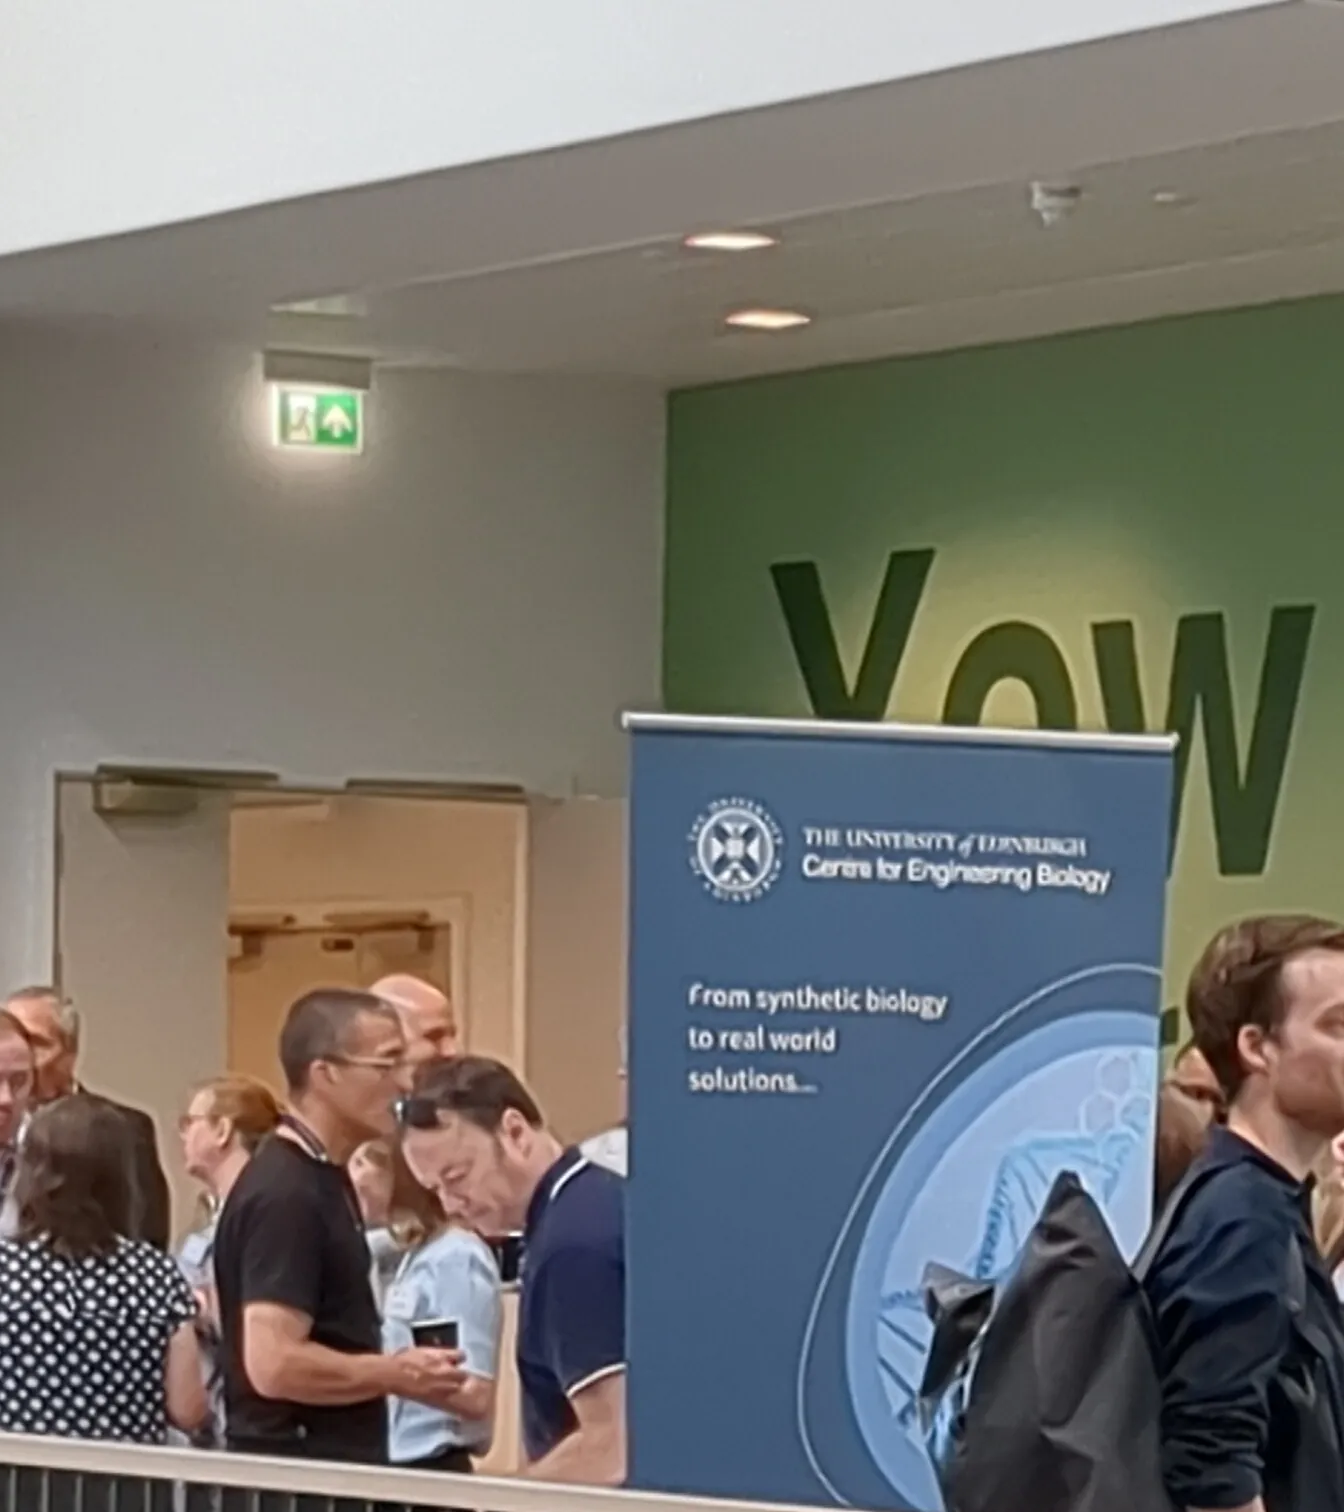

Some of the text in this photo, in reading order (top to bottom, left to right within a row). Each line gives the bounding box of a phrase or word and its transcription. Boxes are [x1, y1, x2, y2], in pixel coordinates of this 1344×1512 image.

[803, 827, 840, 847] THE
[846, 829, 956, 851] UNIVERSITY
[977, 834, 1086, 857] EDINBURGH
[802, 853, 1111, 895] Centre for Engineering Biology
[689, 982, 948, 1020] From synthetic biology
[689, 1024, 837, 1052] to real world
